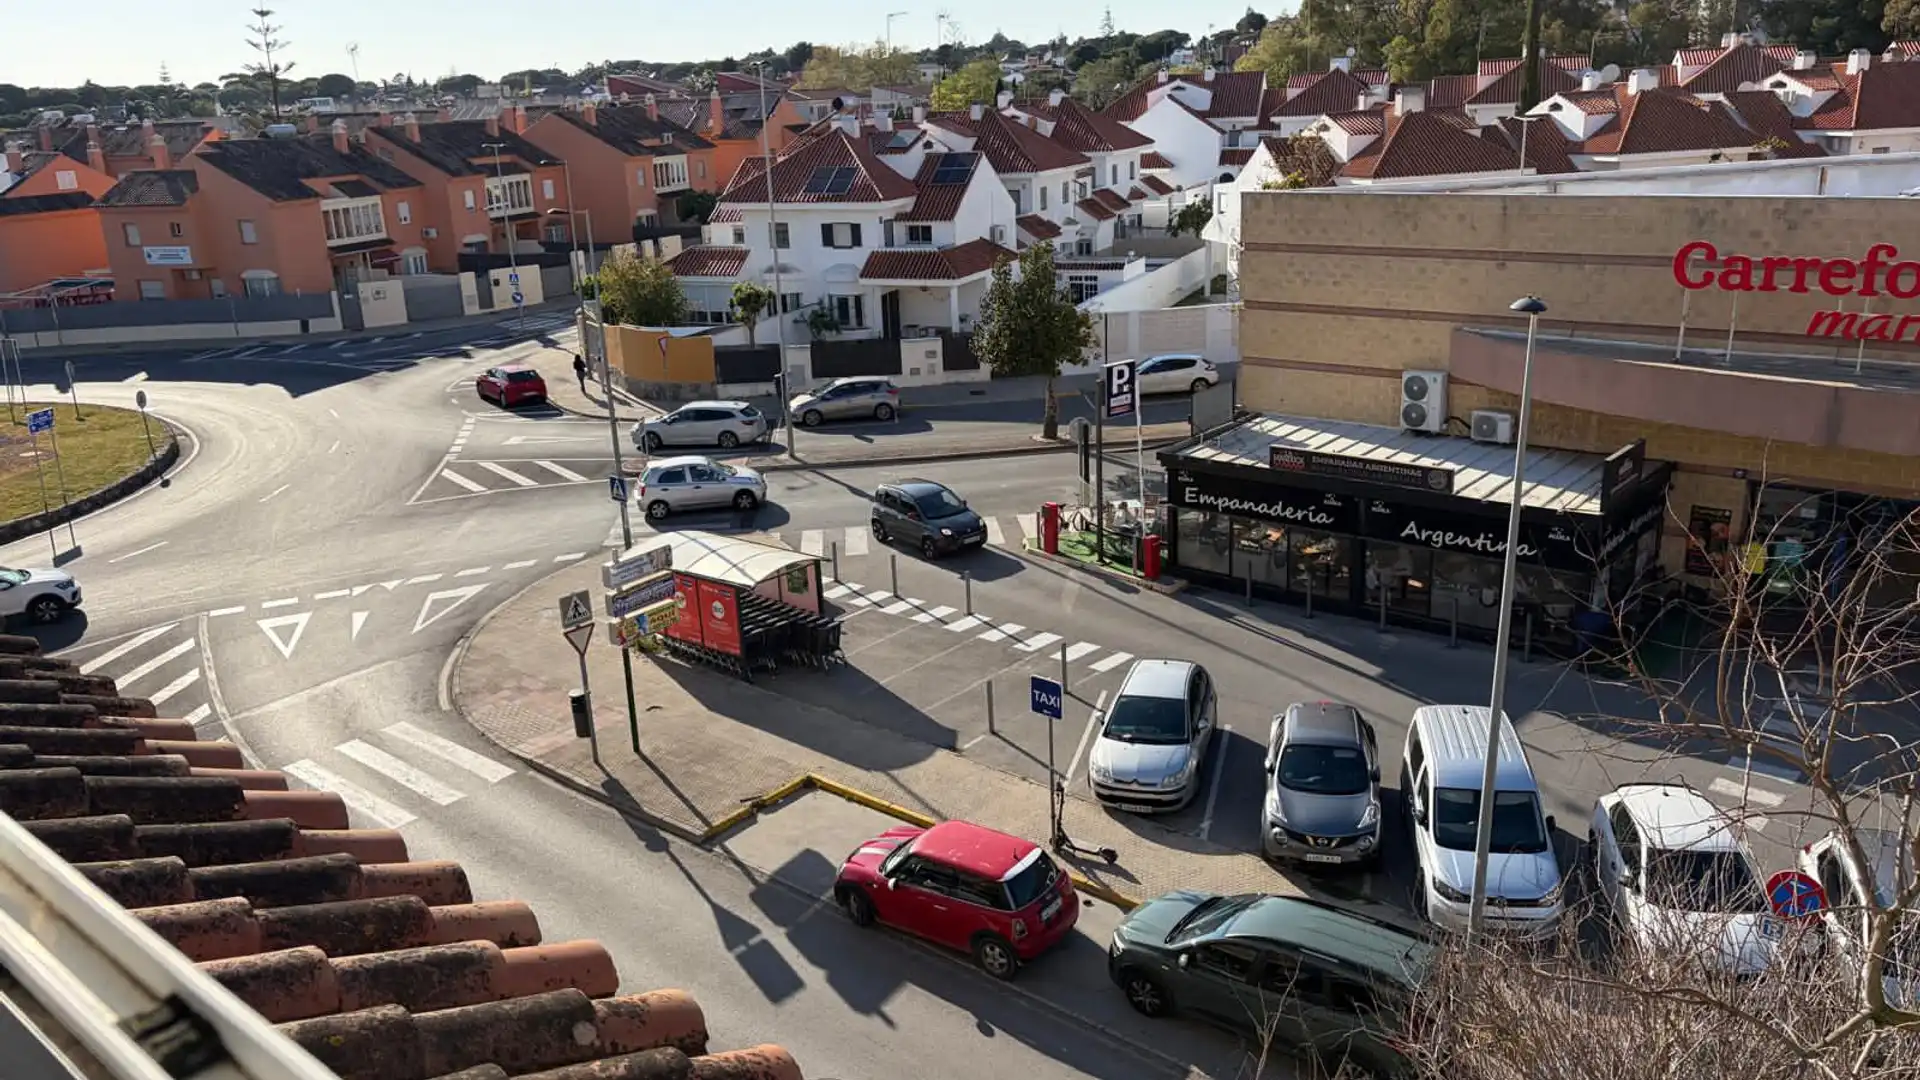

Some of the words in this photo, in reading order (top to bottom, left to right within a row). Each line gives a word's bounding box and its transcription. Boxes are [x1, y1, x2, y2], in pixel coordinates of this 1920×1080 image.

[1673, 240, 1920, 299] Carrefo
[1806, 310, 1920, 346] mar
[1112, 364, 1130, 395] P
[1184, 486, 1335, 524] Empanadería
[1033, 689, 1060, 709] TAXI
